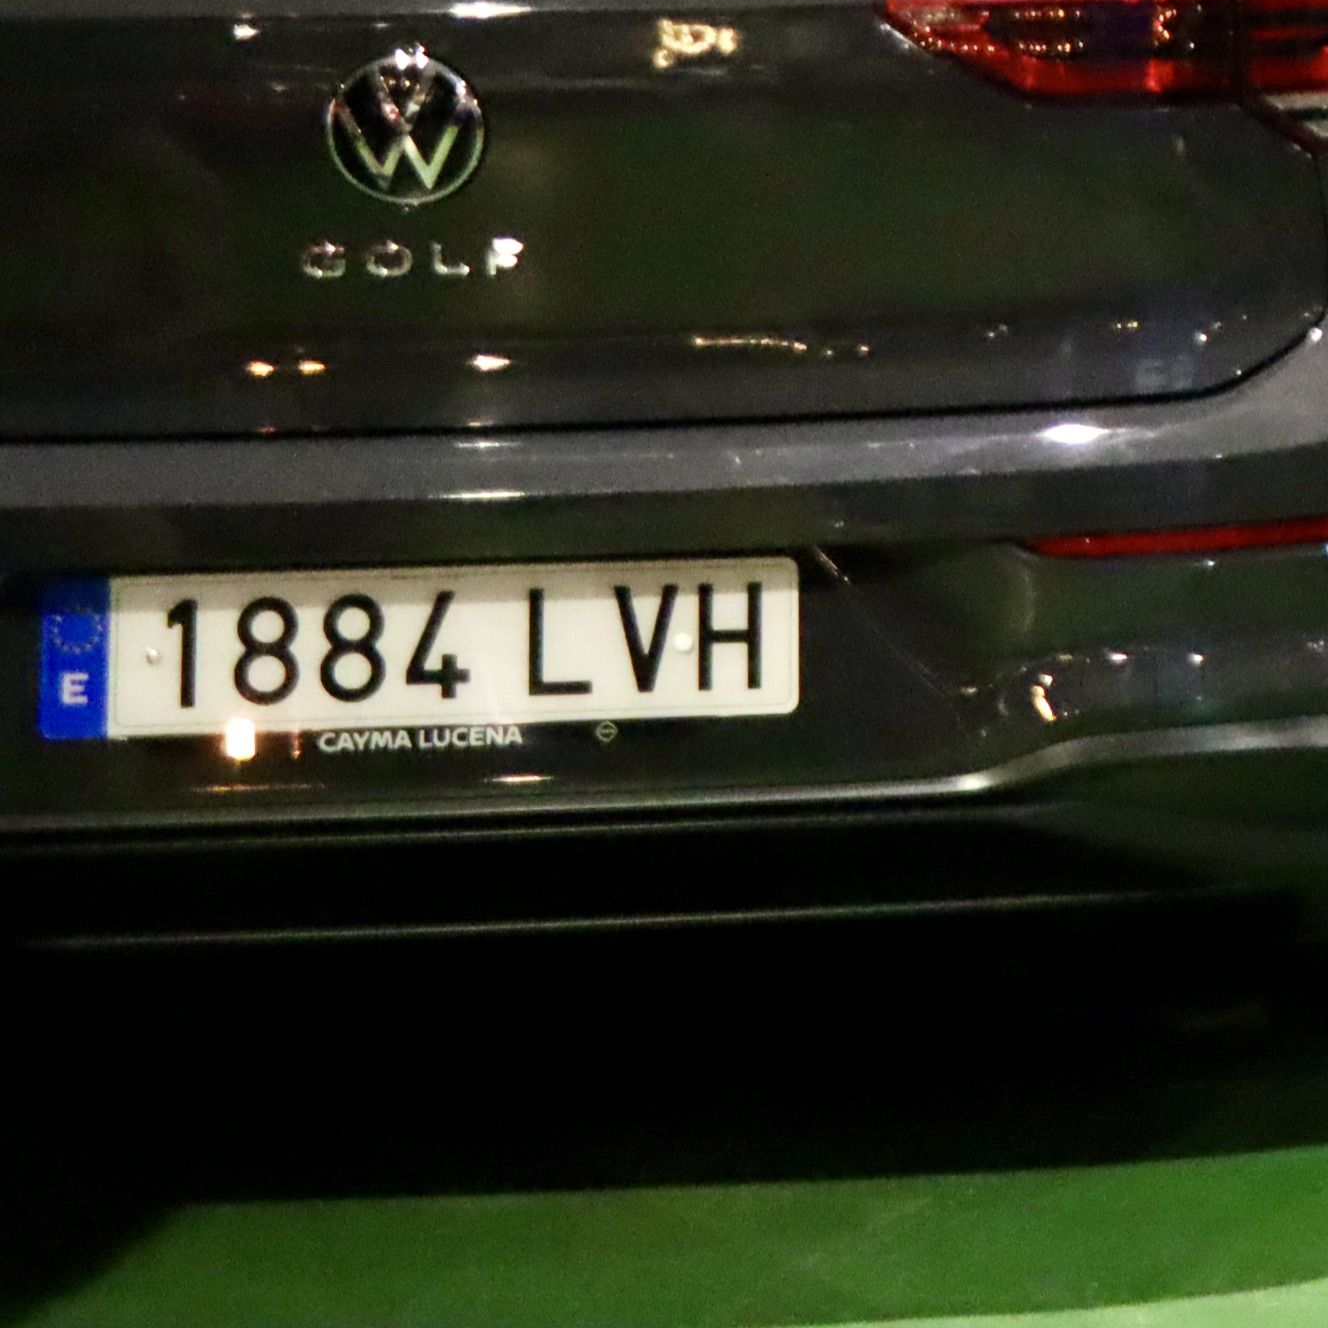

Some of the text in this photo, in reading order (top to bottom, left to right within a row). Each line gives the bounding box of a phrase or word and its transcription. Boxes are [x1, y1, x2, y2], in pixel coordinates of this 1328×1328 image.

[302, 237, 524, 277] GOLF
[165, 581, 764, 708] 1884 LVH
[60, 672, 89, 706] E
[318, 725, 523, 753] CAYMA LUCENA
